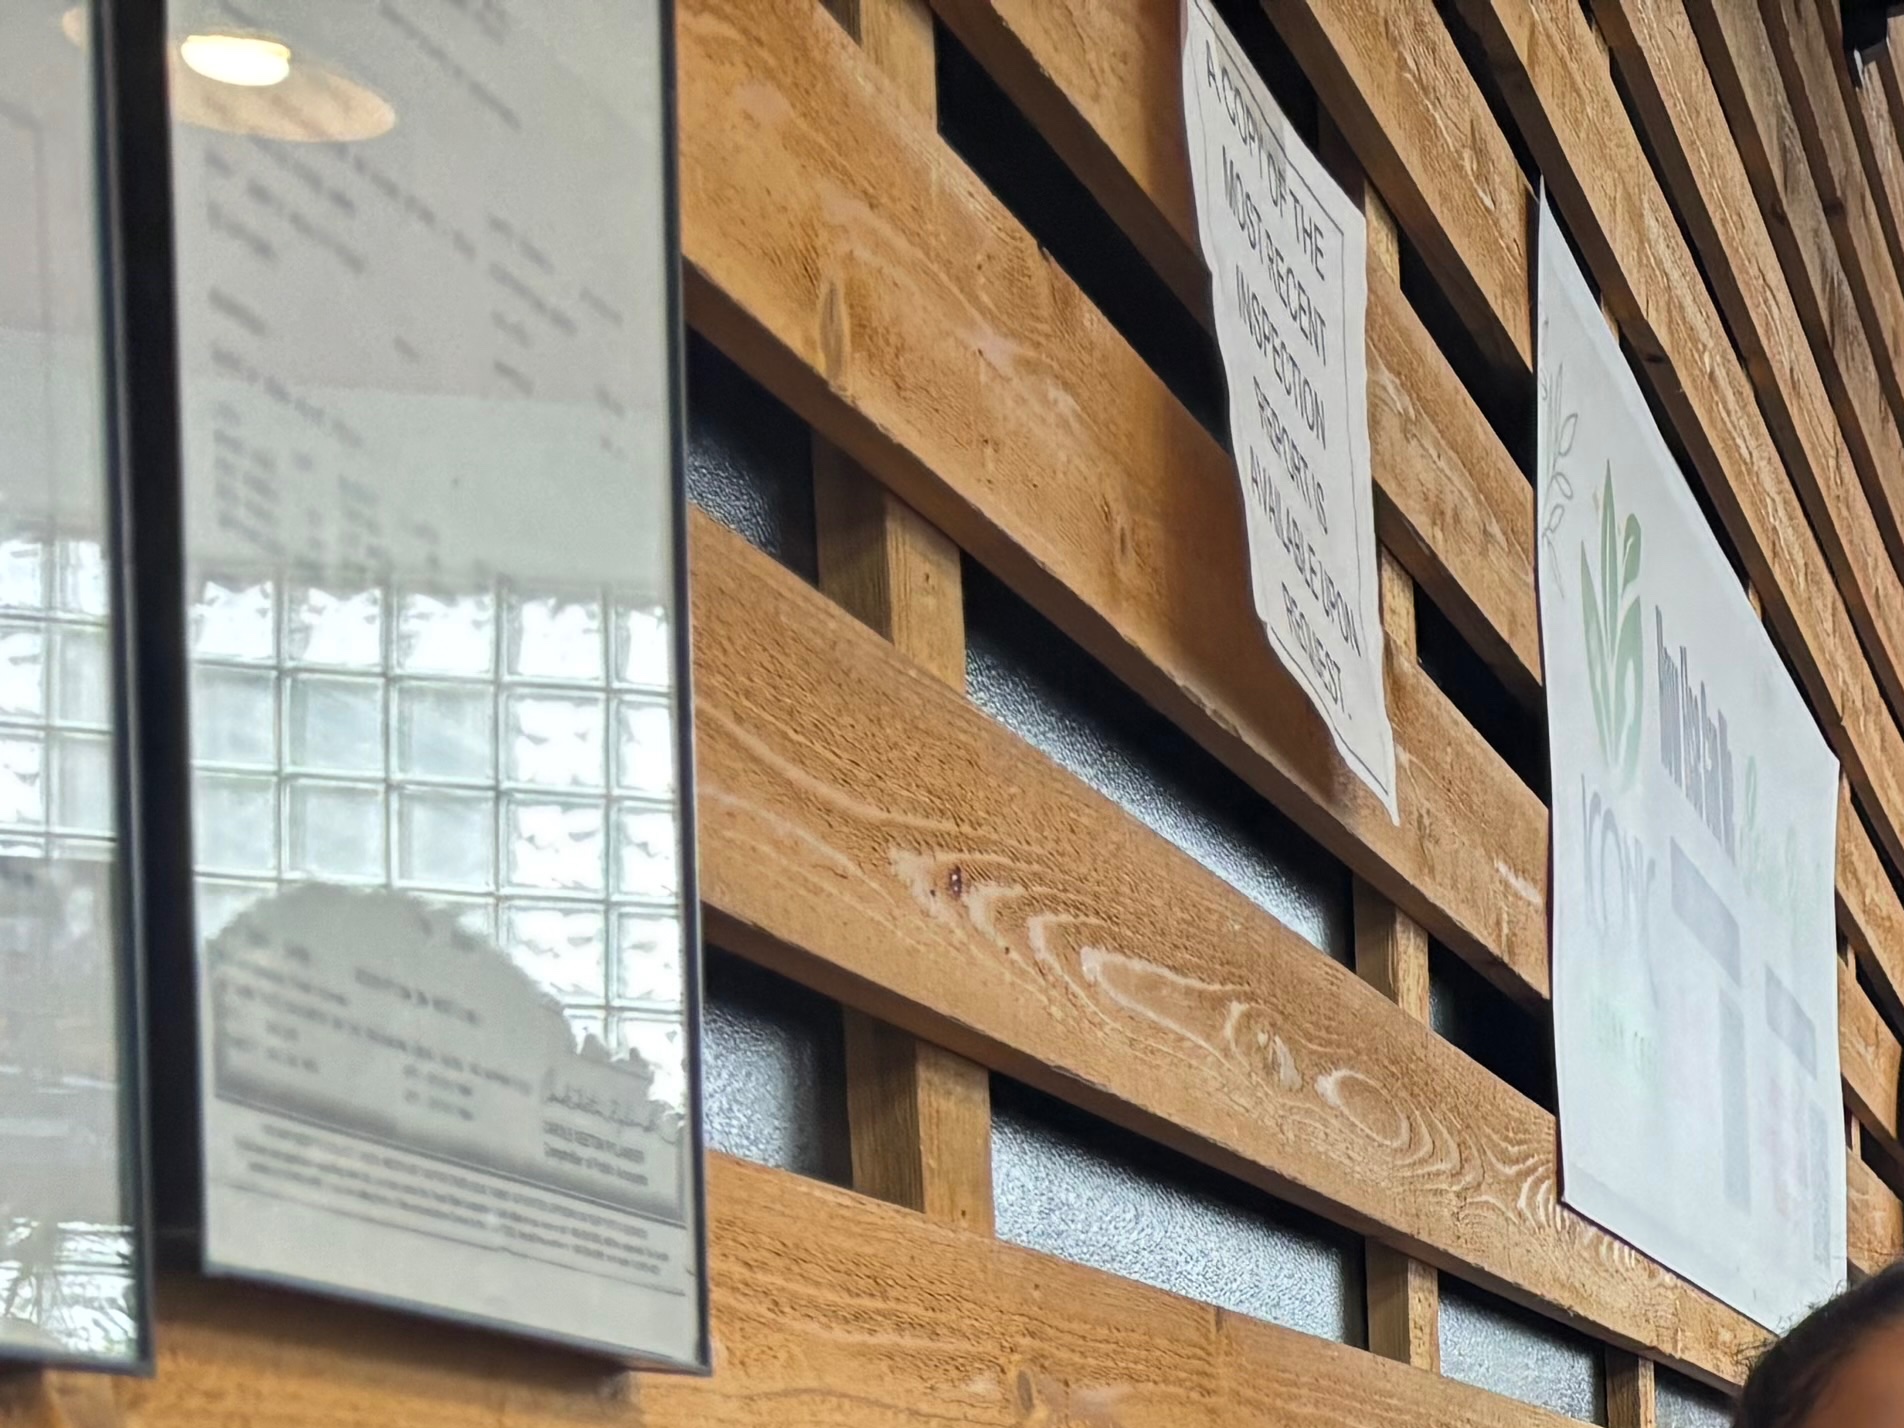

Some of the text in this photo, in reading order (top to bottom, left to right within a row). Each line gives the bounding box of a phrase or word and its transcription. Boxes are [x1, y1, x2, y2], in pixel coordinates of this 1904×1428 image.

[1206, 39, 1325, 282] A COPY OF THE
[1221, 144, 1327, 368] MOST RECENT
[1236, 263, 1327, 451] INSPECTION
[1253, 375, 1328, 535] REPORT IS
